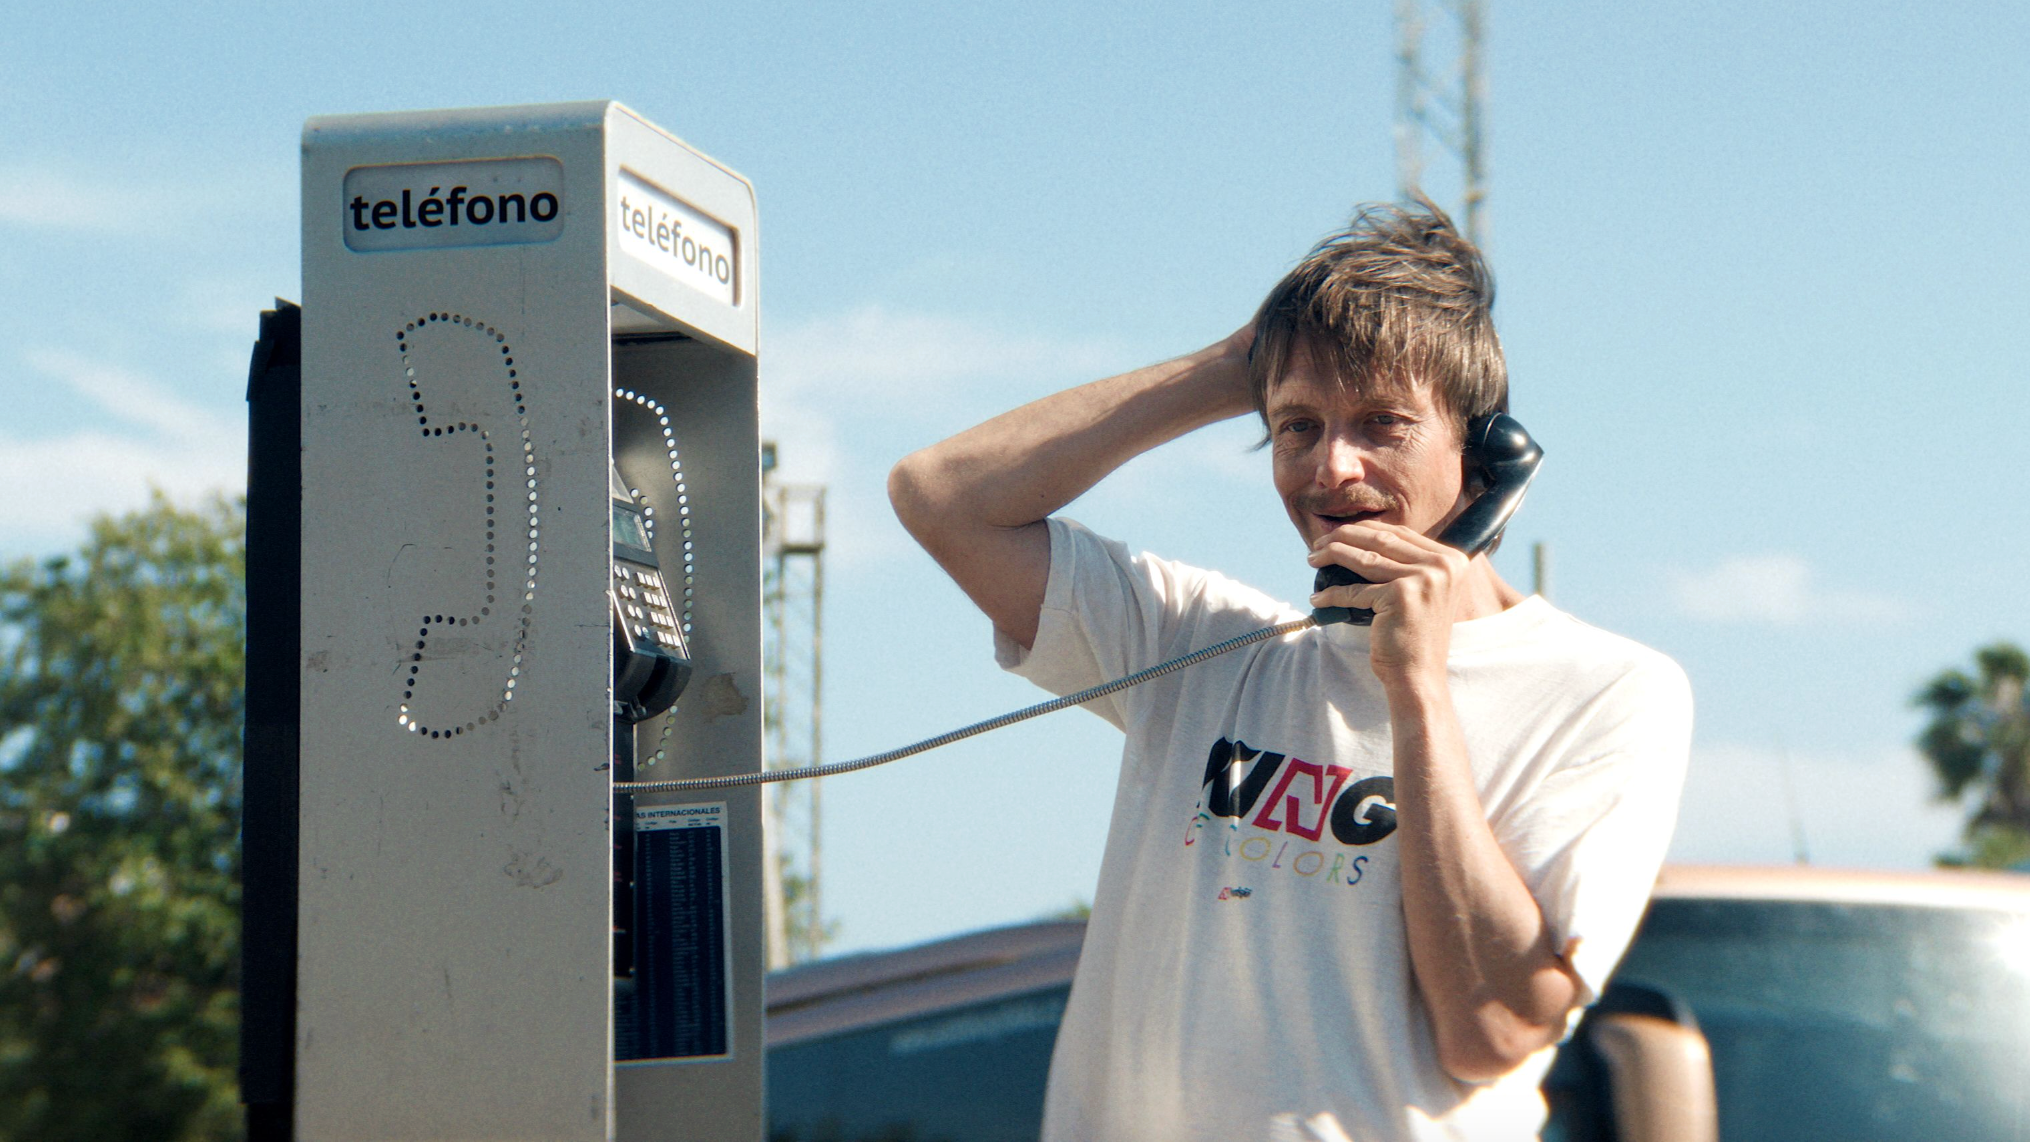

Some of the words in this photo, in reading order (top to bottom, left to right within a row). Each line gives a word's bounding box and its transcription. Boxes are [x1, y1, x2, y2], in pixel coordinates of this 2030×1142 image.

[350, 187, 559, 231] teléfono
[620, 195, 731, 285] teléfono
[648, 807, 720, 817] INTERNACIONALES
